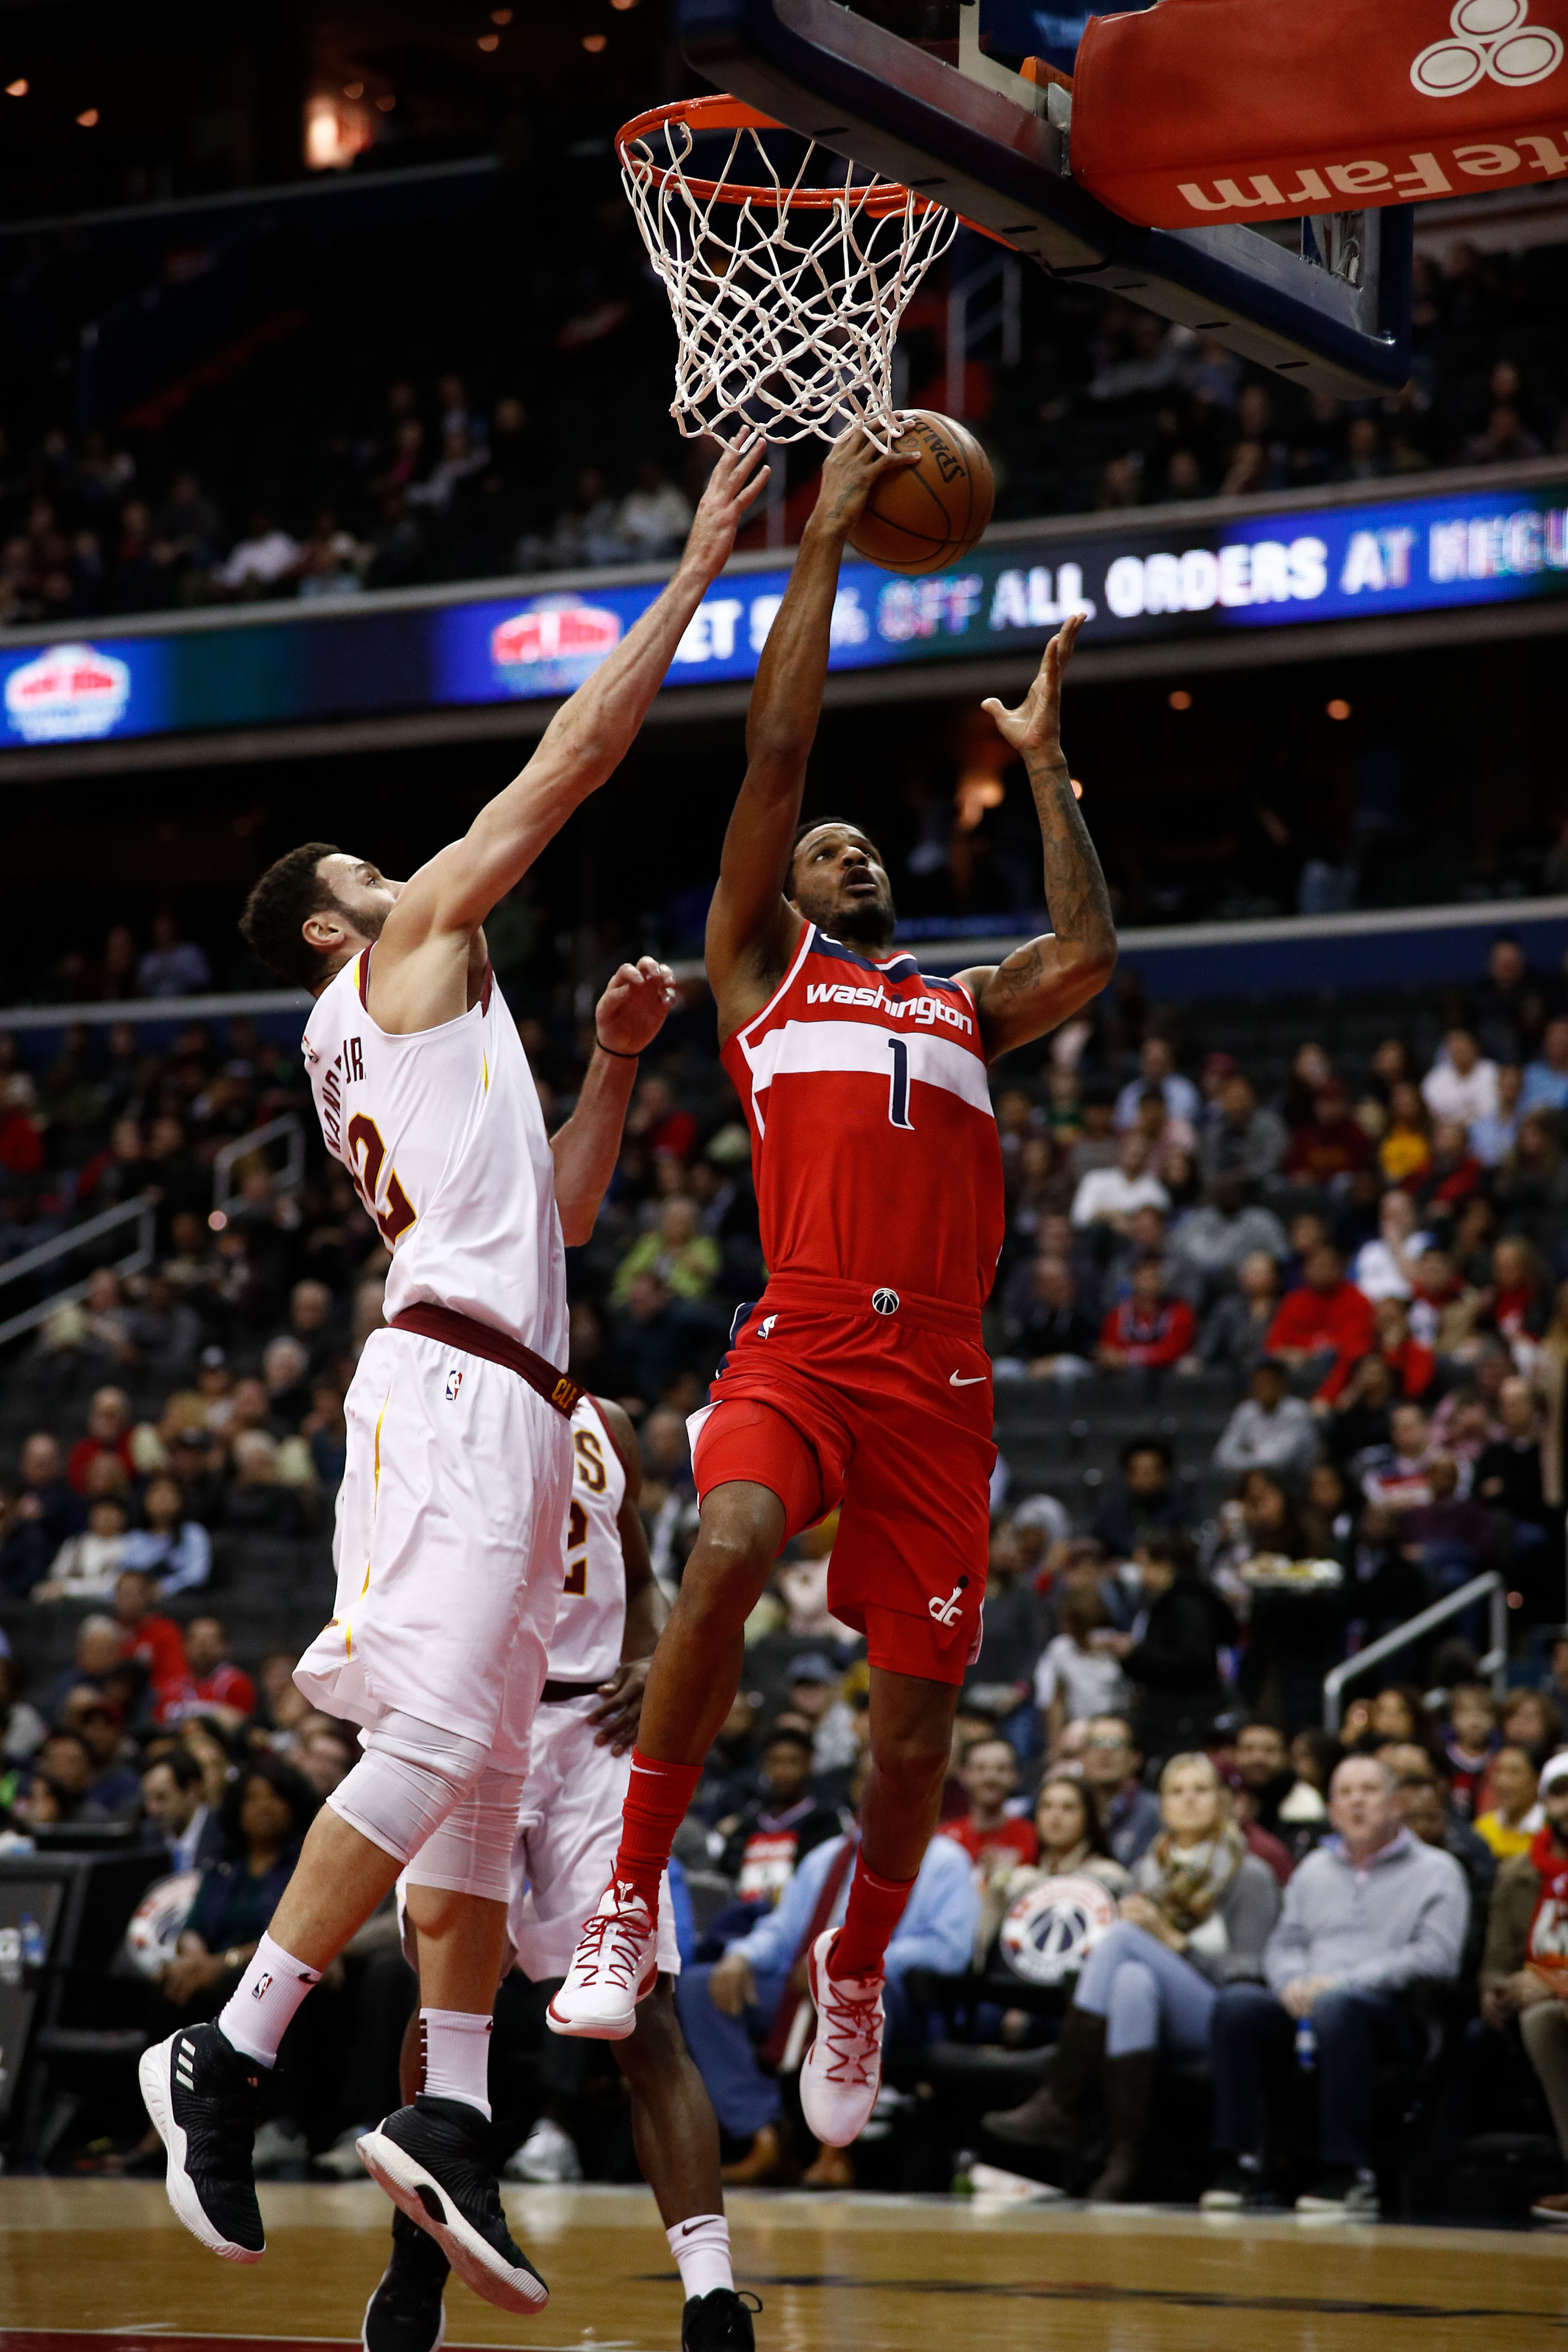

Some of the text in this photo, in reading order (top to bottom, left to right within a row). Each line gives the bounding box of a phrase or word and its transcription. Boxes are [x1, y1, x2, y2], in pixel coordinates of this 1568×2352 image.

[1177, 130, 1568, 211] teFarm
[910, 415, 966, 483] SPALD
[671, 599, 743, 662] ET
[988, 562, 1097, 631] ALL
[1106, 537, 1328, 618] ORDERS
[1340, 525, 1418, 595] AT
[807, 983, 972, 1035] washington
[888, 1038, 915, 1130] 1
[347, 1112, 417, 1254] 2
